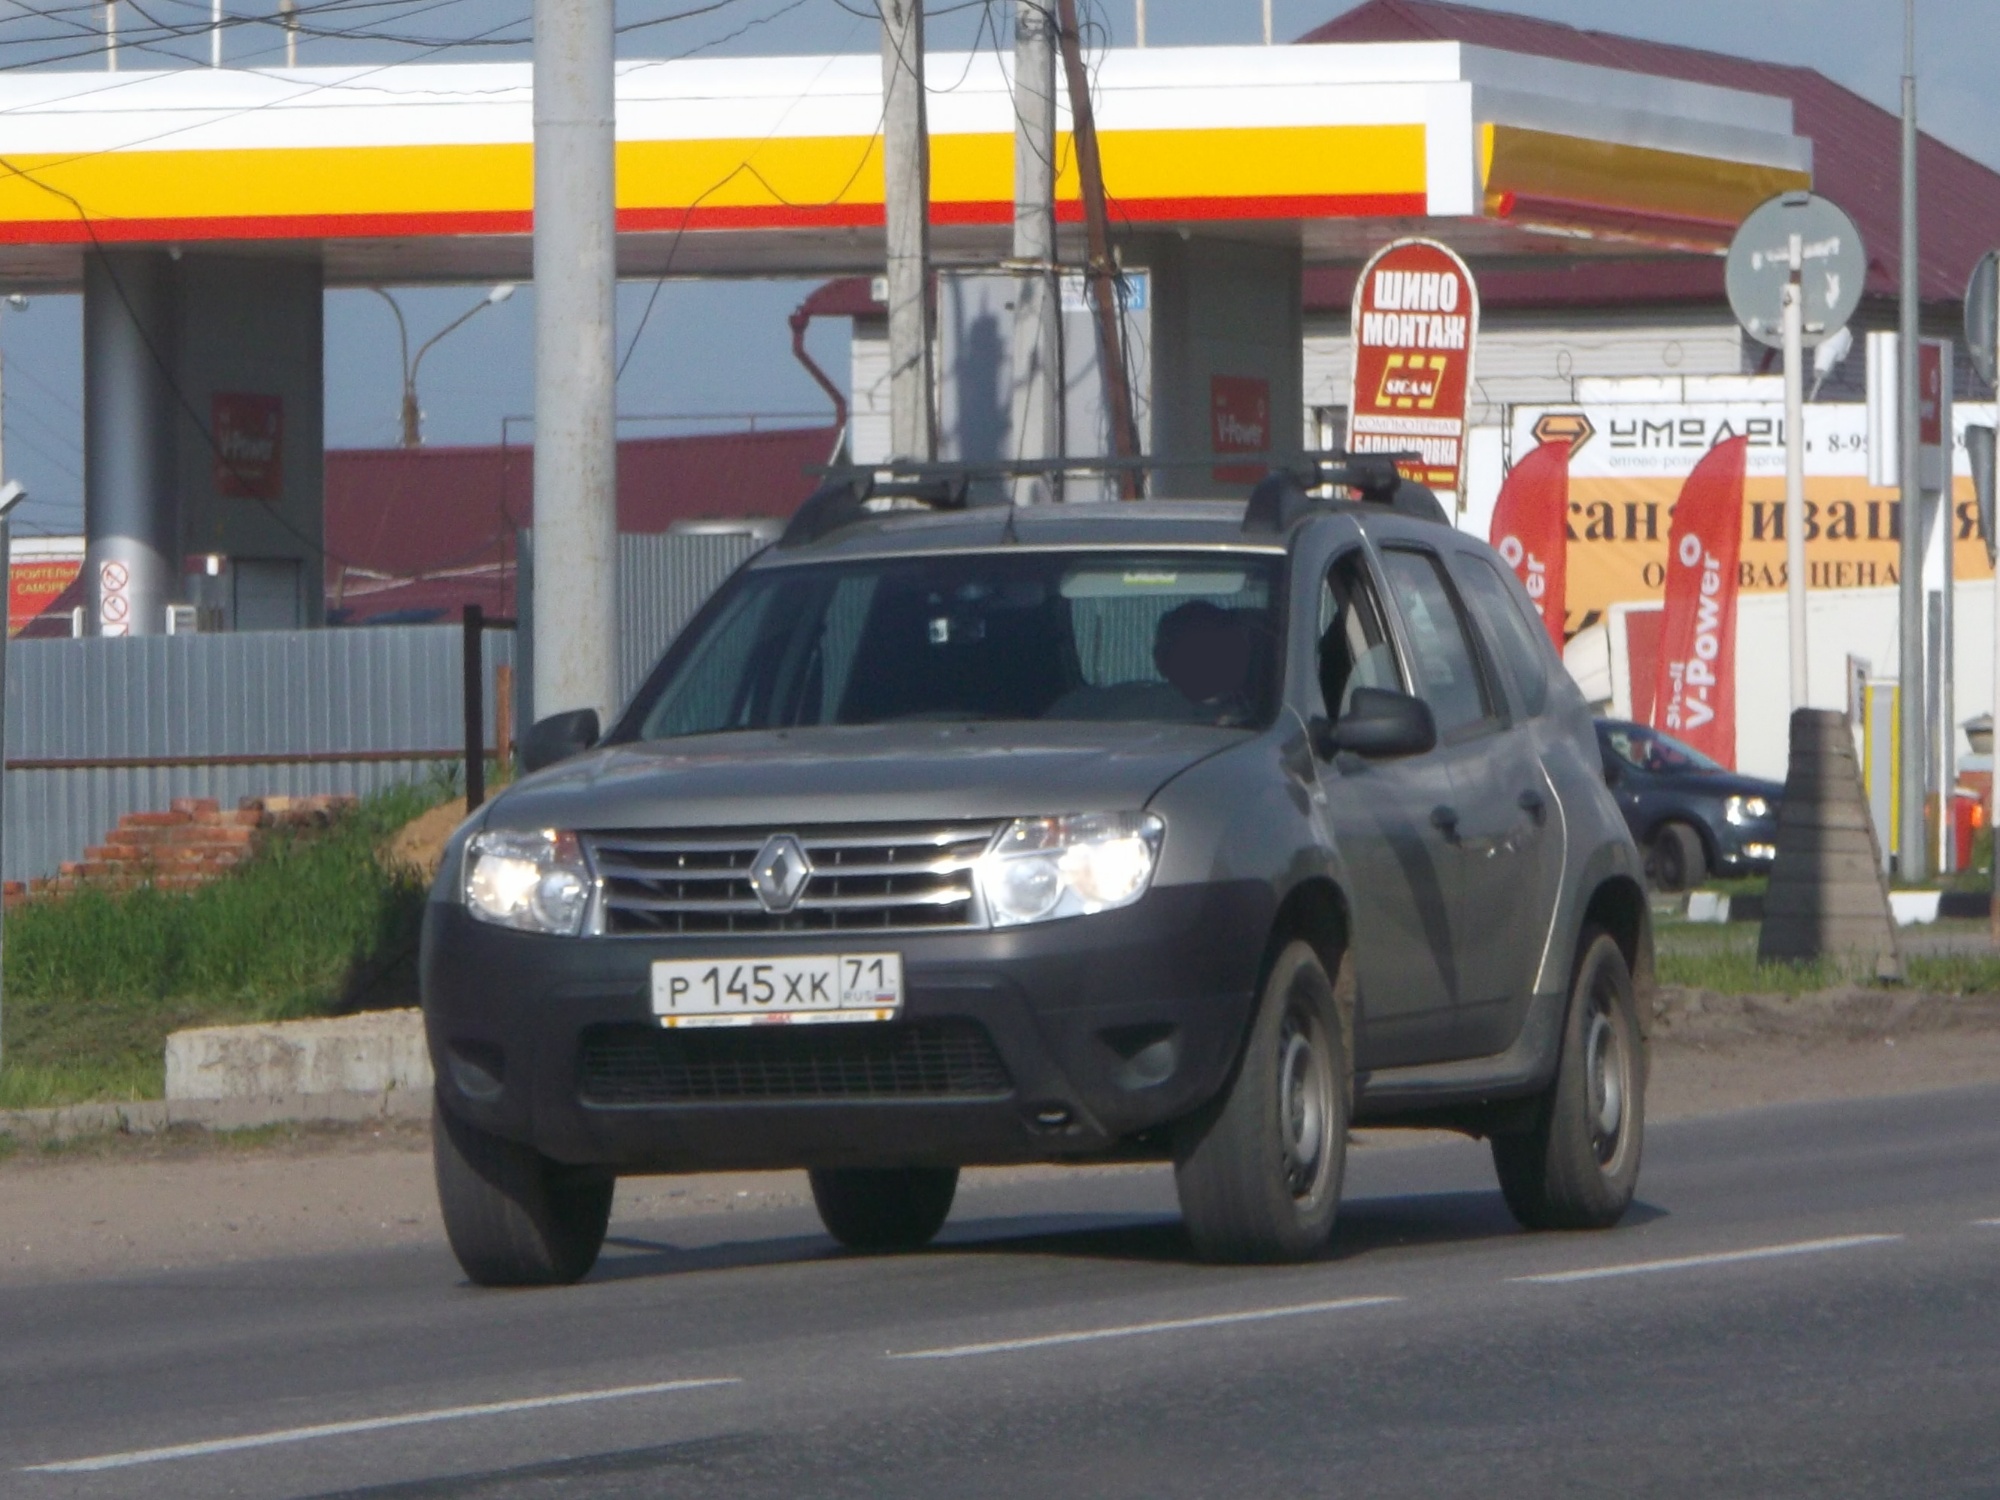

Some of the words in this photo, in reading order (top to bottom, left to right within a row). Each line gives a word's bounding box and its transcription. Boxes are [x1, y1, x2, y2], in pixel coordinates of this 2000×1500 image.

[1373, 270, 1459, 313] ШИНО
[1362, 311, 1467, 350] МОНТАЖ
[1685, 550, 1722, 730] V-Power
[1667, 660, 1686, 730] Shell
